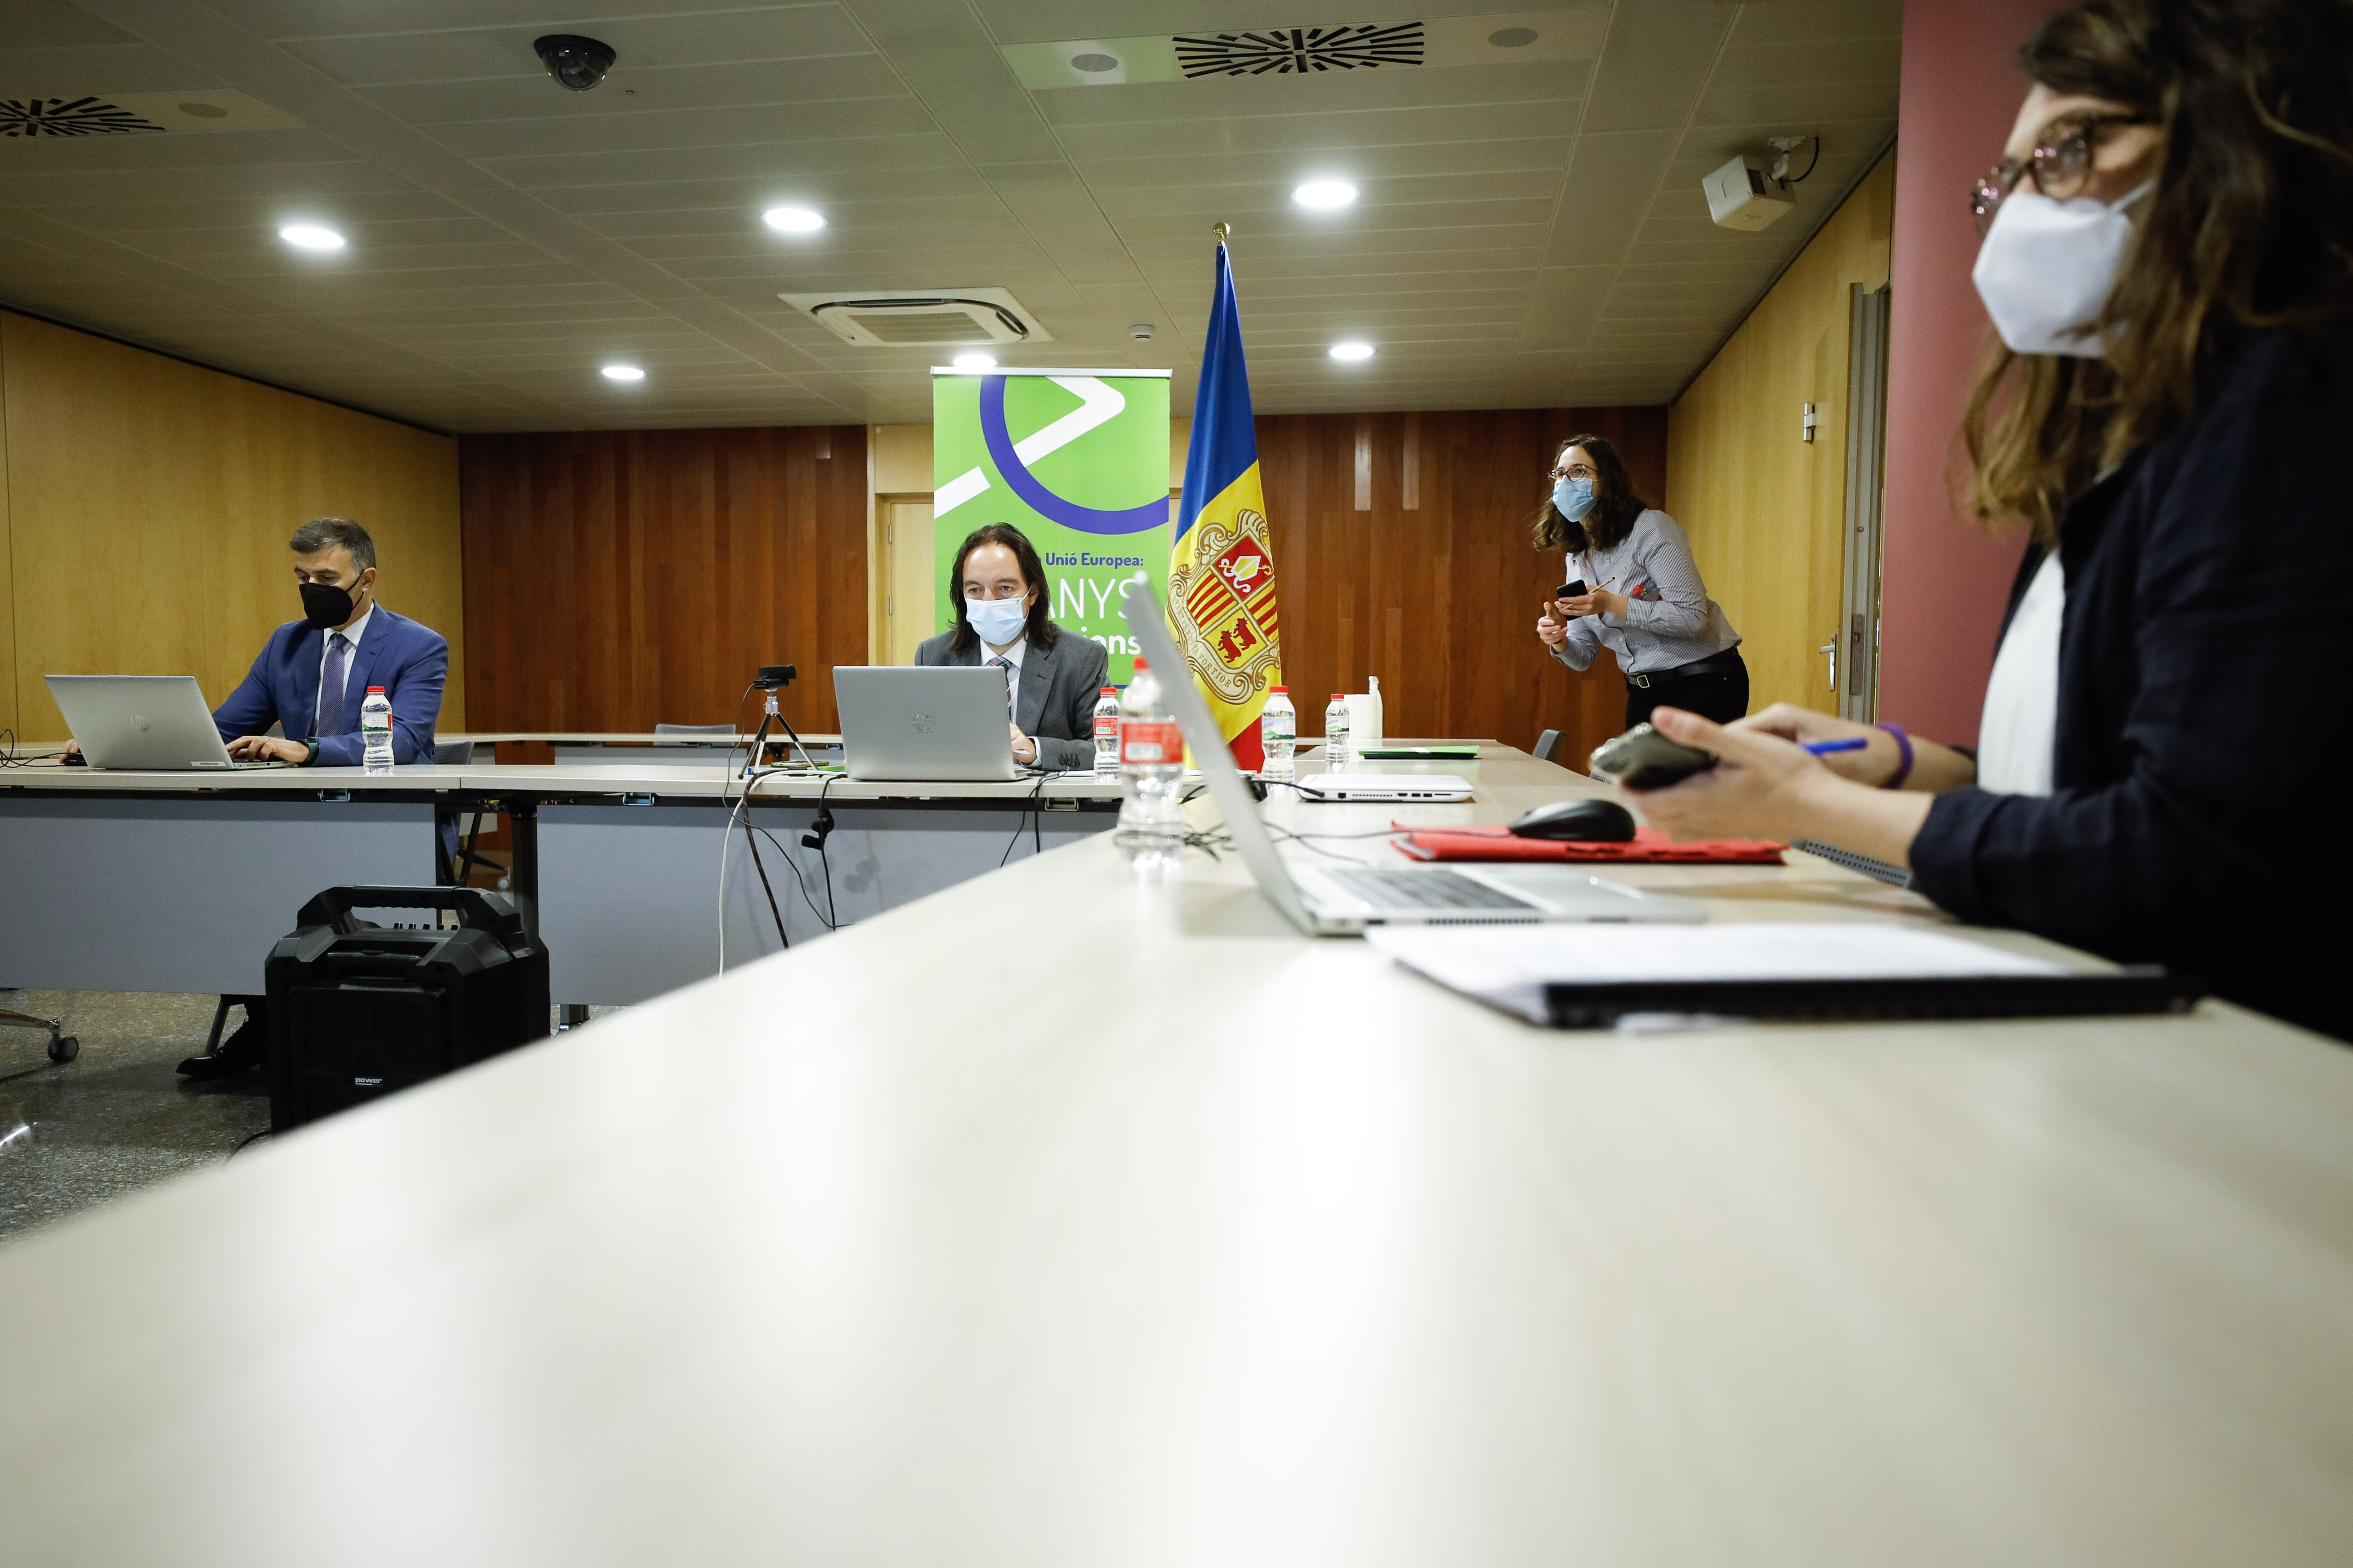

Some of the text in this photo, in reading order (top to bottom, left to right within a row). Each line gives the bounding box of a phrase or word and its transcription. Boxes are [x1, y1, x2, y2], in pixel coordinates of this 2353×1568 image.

[1046, 552, 1078, 566] Unió
[1081, 552, 1144, 570] Europea:
[1197, 654, 1232, 688] FORTIOR
